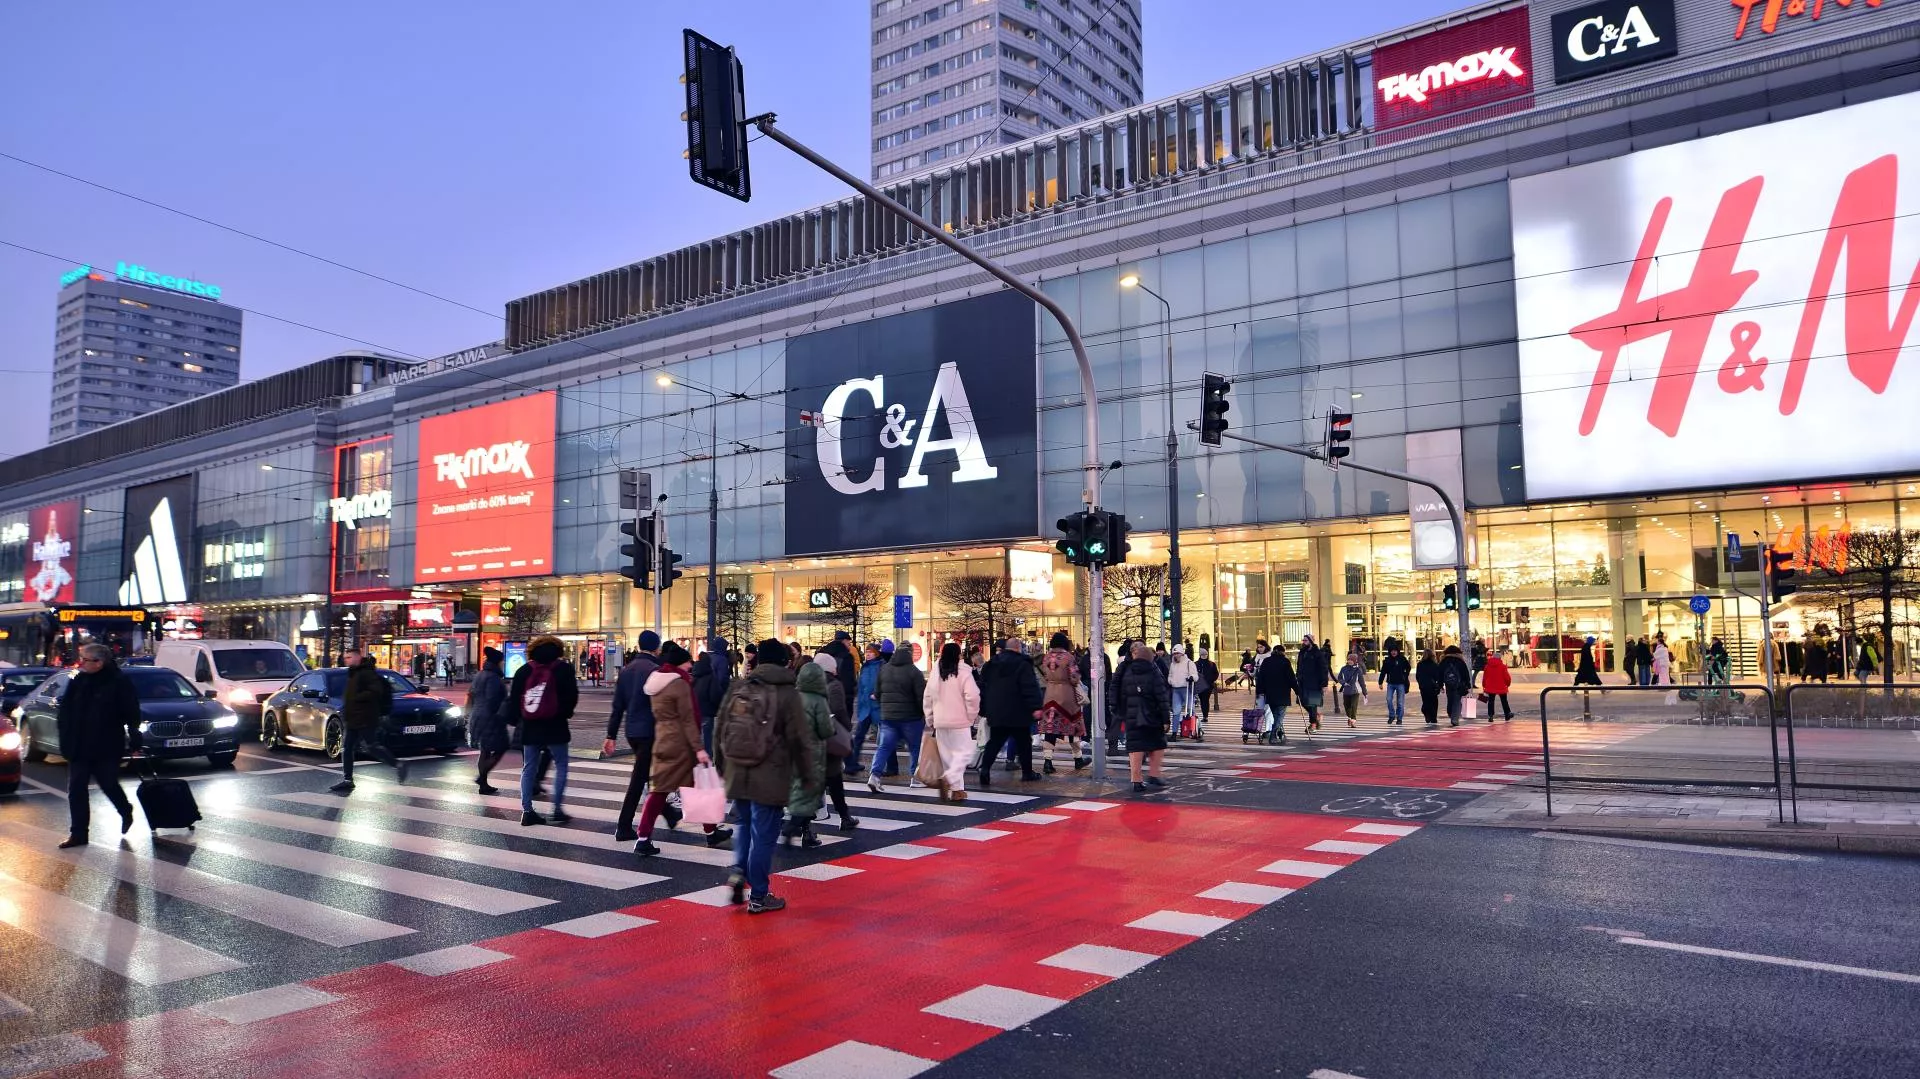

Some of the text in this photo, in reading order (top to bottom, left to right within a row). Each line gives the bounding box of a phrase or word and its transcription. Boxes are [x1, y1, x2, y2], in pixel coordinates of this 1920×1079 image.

[1567, 5, 1660, 62] C&A
[116, 260, 222, 299] Hisense
[388, 347, 487, 385] WARS SAWA
[816, 361, 998, 495] C&A
[478, 497, 488, 509] do
[1764, 521, 1851, 576] HM
